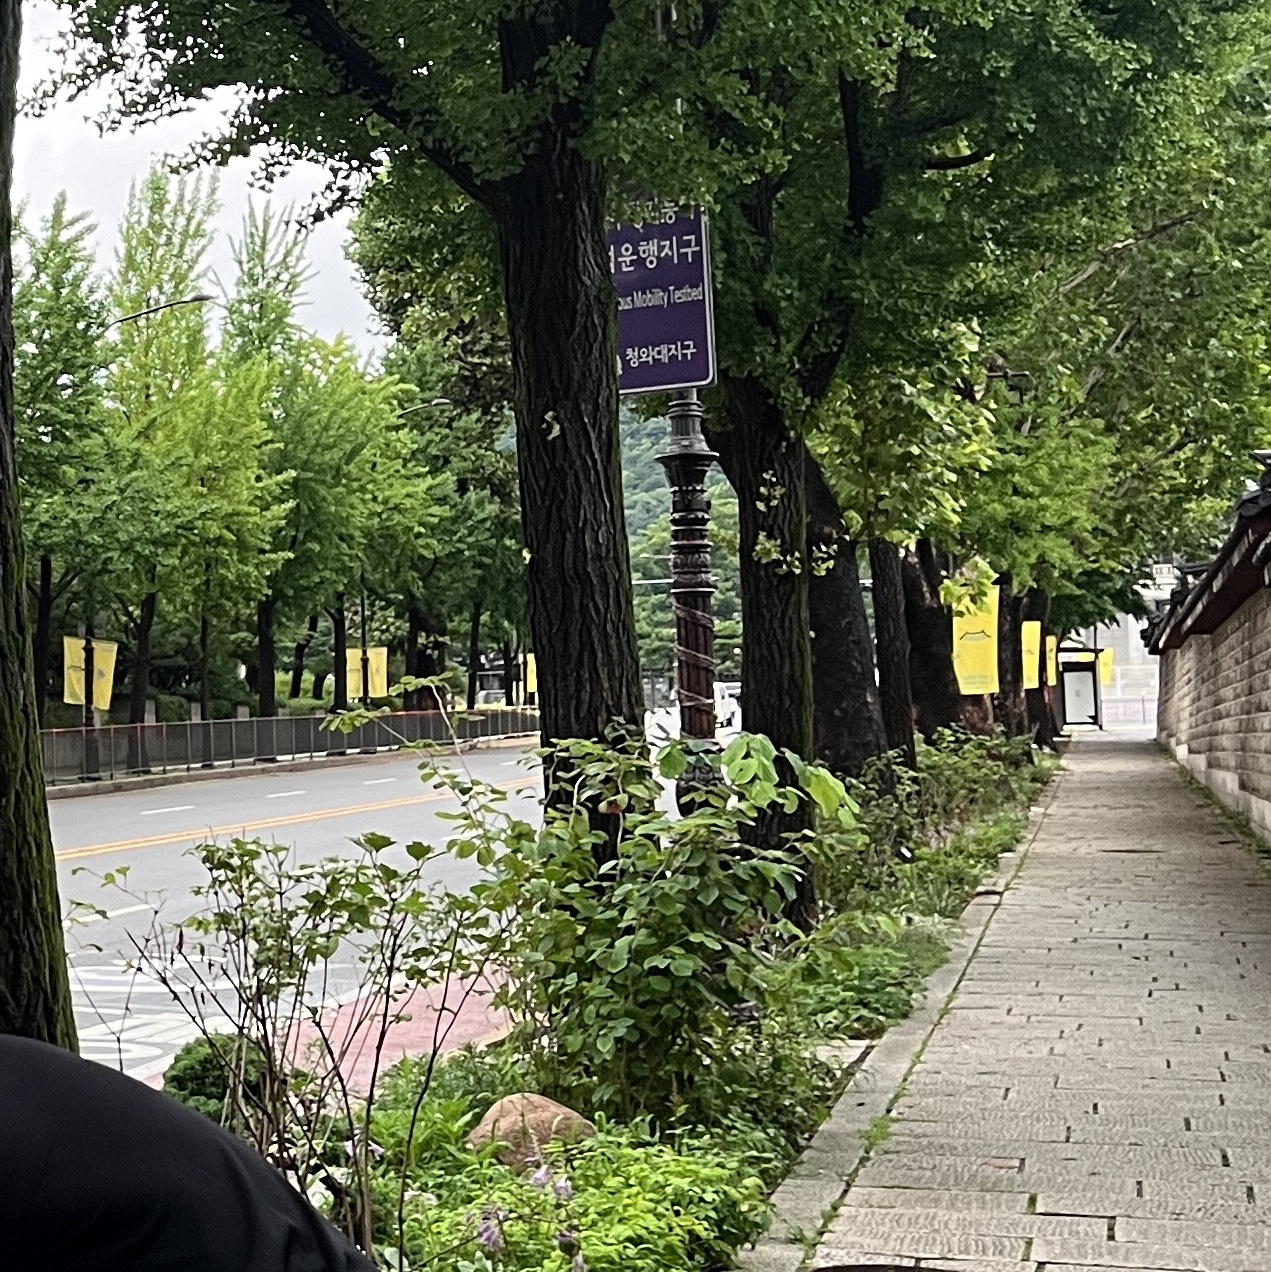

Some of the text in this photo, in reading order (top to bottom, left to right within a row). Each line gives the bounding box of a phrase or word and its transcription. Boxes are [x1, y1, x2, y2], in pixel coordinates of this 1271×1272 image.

[633, 289, 668, 308] Mobility
[668, 282, 703, 303] Testbed
[625, 341, 697, 367] 청와대지구
